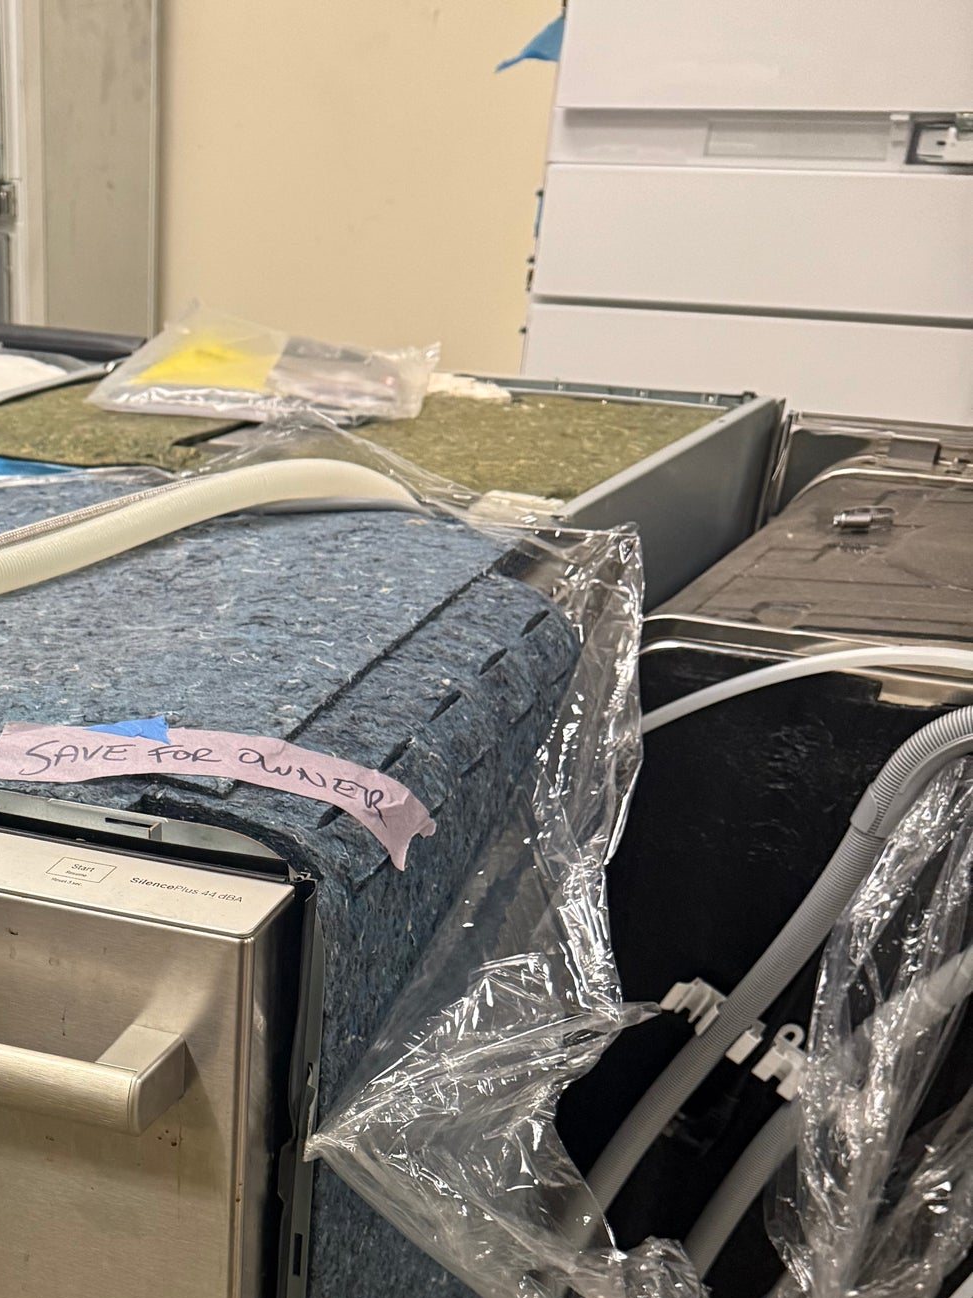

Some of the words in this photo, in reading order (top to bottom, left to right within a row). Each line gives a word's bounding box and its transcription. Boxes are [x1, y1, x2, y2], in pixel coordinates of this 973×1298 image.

[19, 740, 138, 776] SAVE
[147, 744, 225, 765] FOR
[238, 747, 390, 829] OWNER
[71, 863, 95, 873] Start
[129, 876, 199, 896] SilencePlus
[200, 889, 217, 900] 44
[217, 892, 244, 903] dBA
